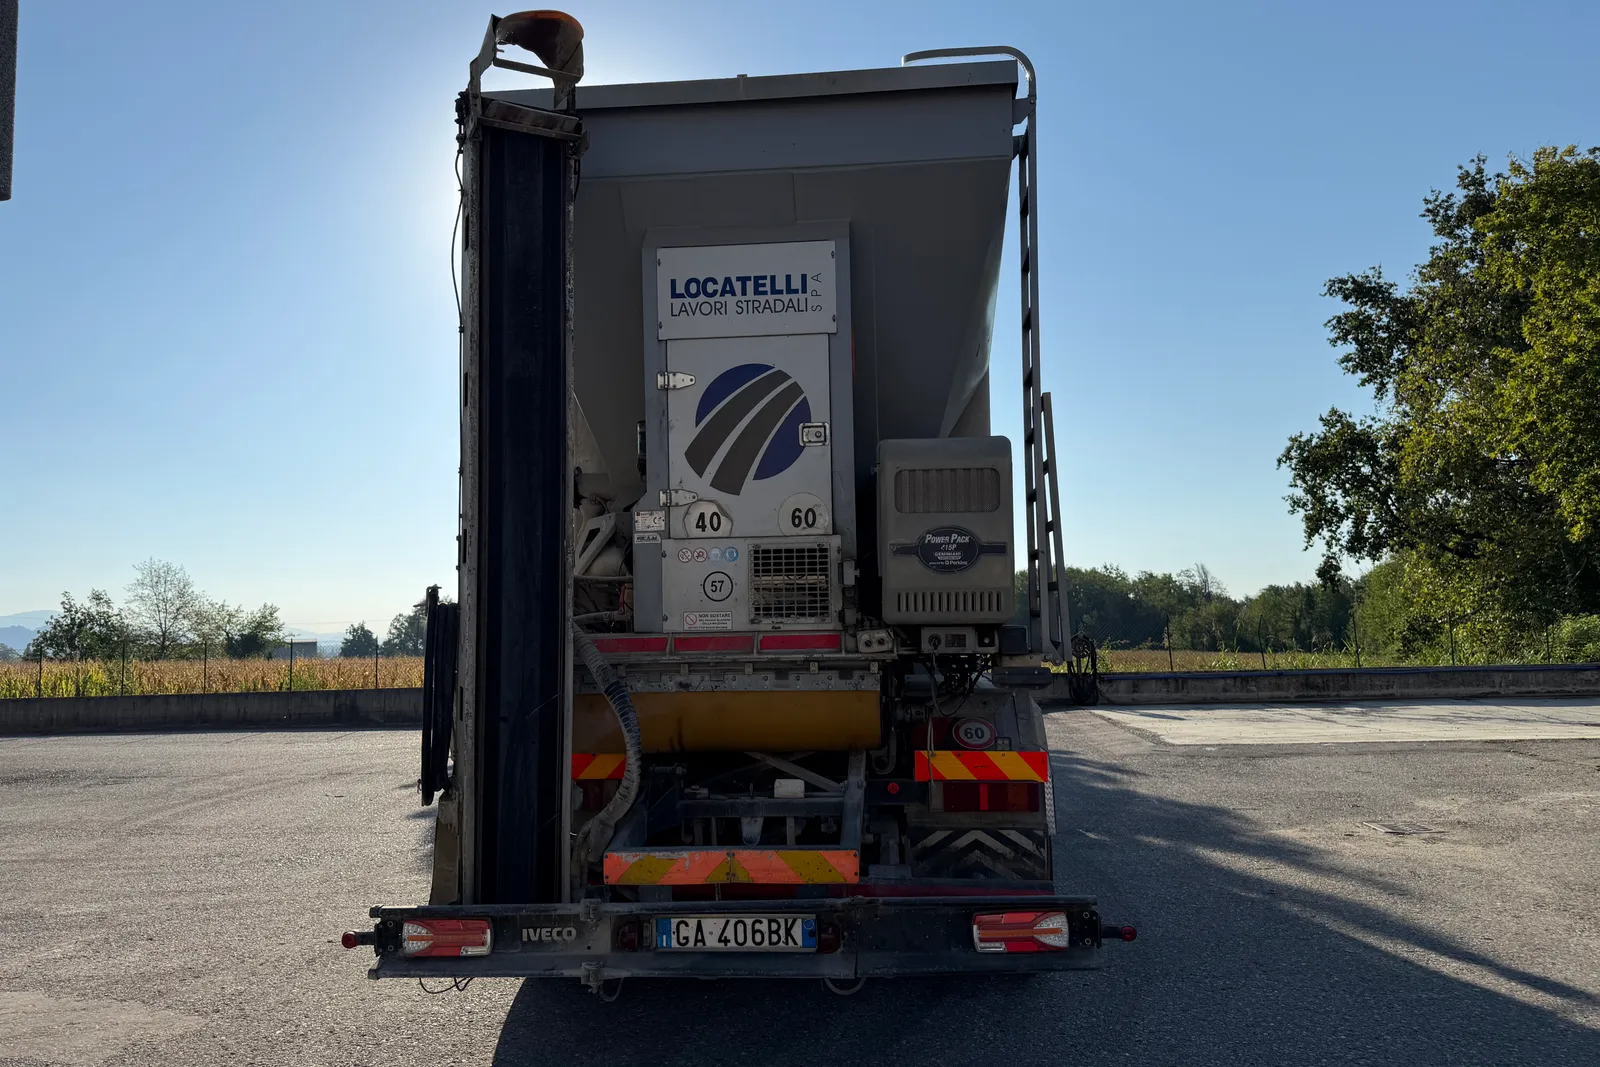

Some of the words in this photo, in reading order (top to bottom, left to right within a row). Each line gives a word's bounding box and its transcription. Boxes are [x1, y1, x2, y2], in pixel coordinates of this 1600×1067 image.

[670, 273, 808, 300] LOCATELLI
[670, 300, 728, 317] LAVORI
[735, 297, 808, 315] STRADALI
[695, 511, 722, 533] 40
[791, 507, 817, 528] 60
[710, 580, 724, 593] 57
[964, 727, 984, 739] 60
[522, 926, 577, 942] IVECO
[675, 919, 706, 947] GA
[717, 918, 799, 947] 406BK
